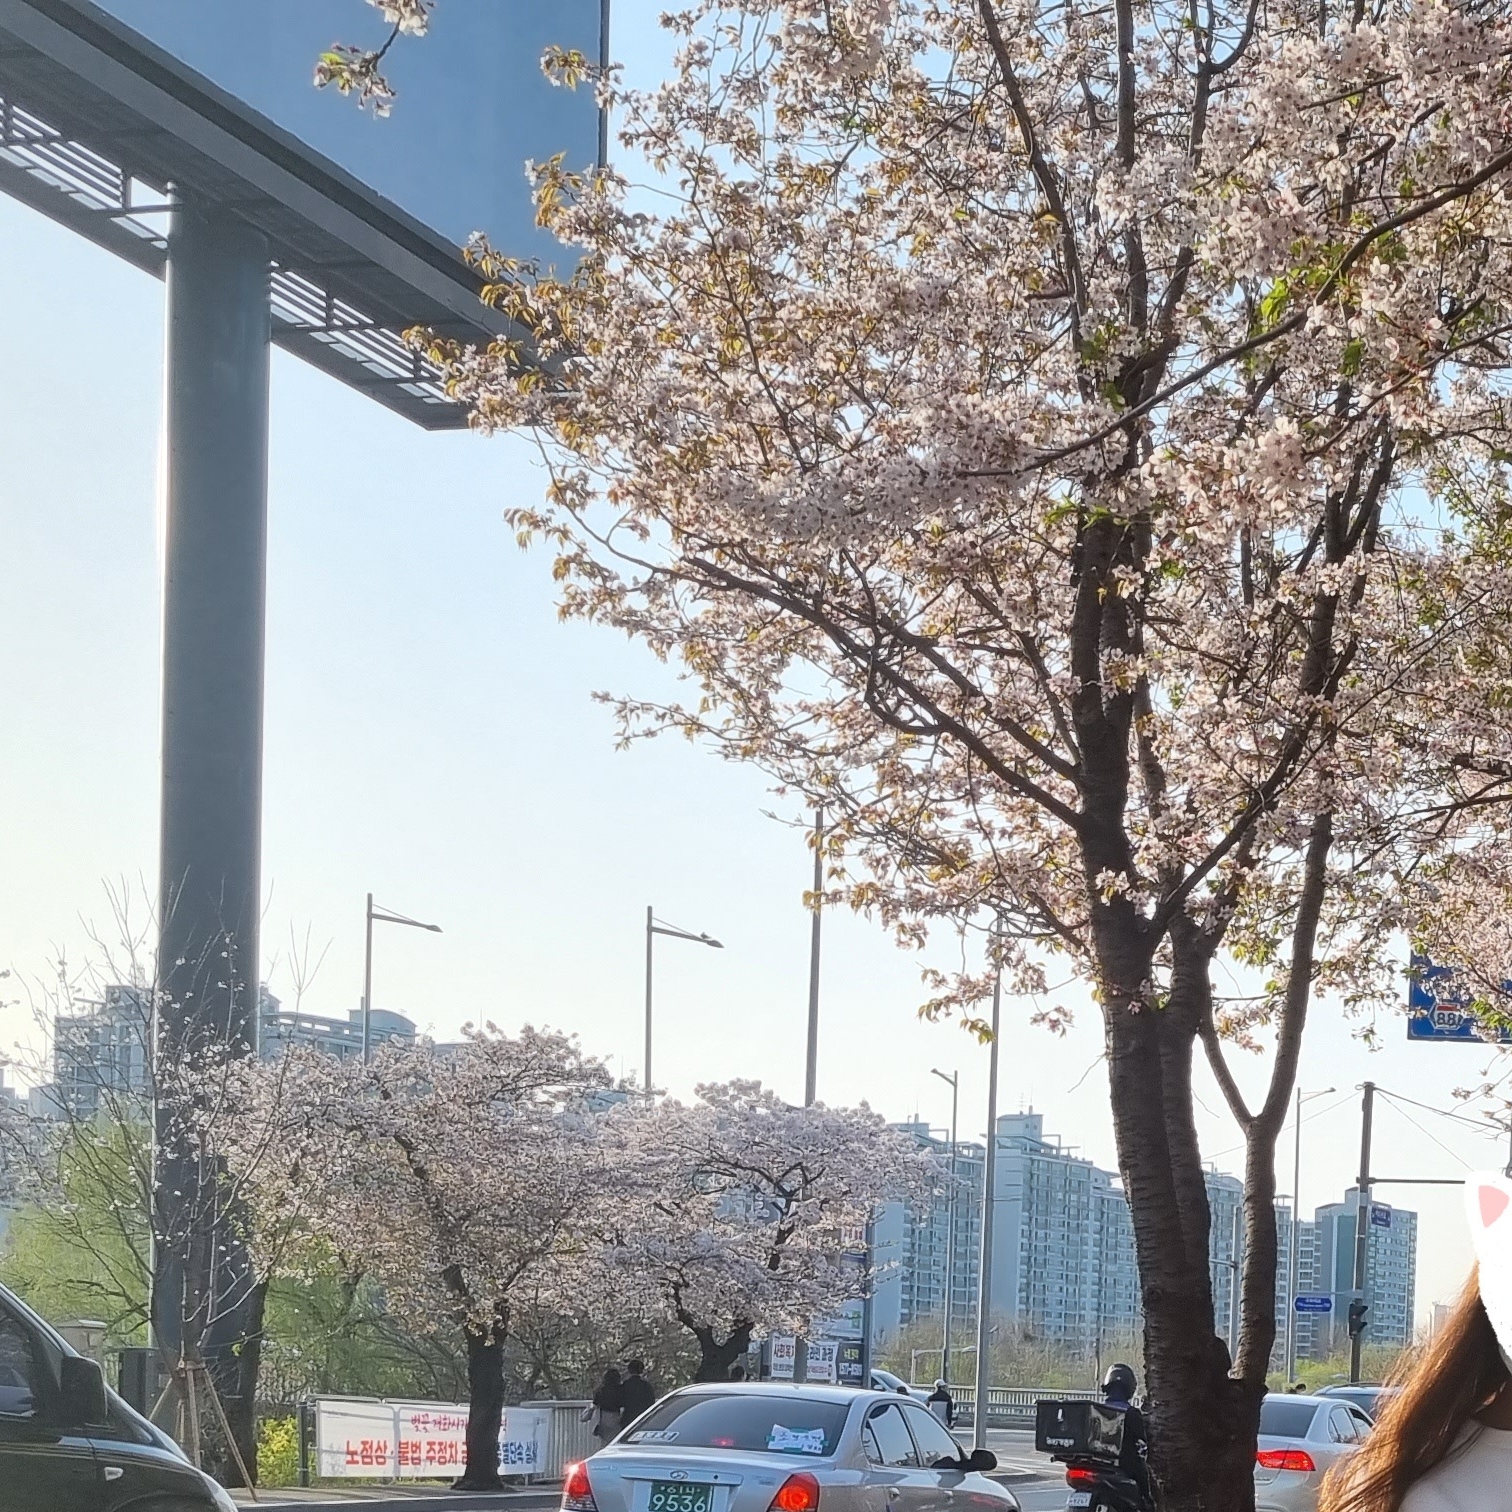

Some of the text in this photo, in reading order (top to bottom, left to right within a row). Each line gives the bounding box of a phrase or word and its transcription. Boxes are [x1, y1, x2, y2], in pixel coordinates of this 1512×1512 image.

[398, 1440, 421, 1466] 불법
[426, 1440, 458, 1466] 주정차
[653, 1493, 706, 1512] 9536
